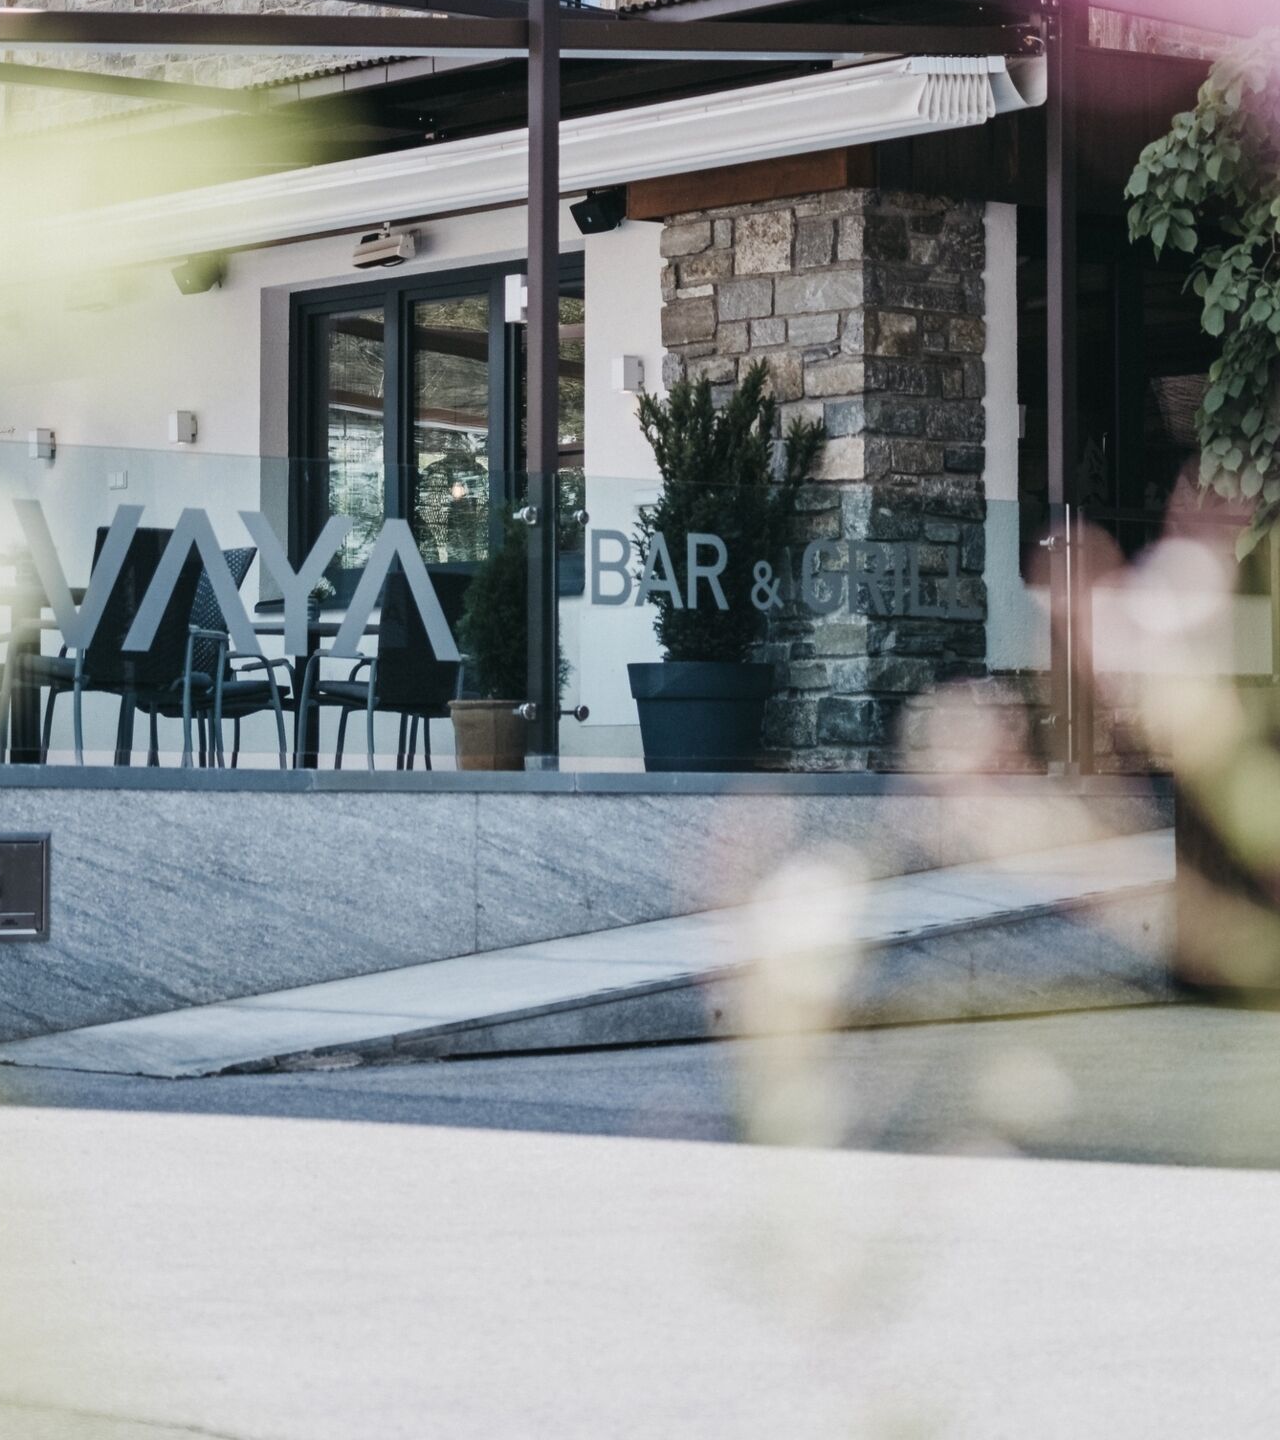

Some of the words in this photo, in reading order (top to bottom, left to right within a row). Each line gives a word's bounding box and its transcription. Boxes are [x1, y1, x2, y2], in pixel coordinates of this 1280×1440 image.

[12, 499, 462, 661] VAYA
[590, 528, 731, 611] BAR
[751, 560, 784, 610] &
[802, 537, 982, 619] GRILL
